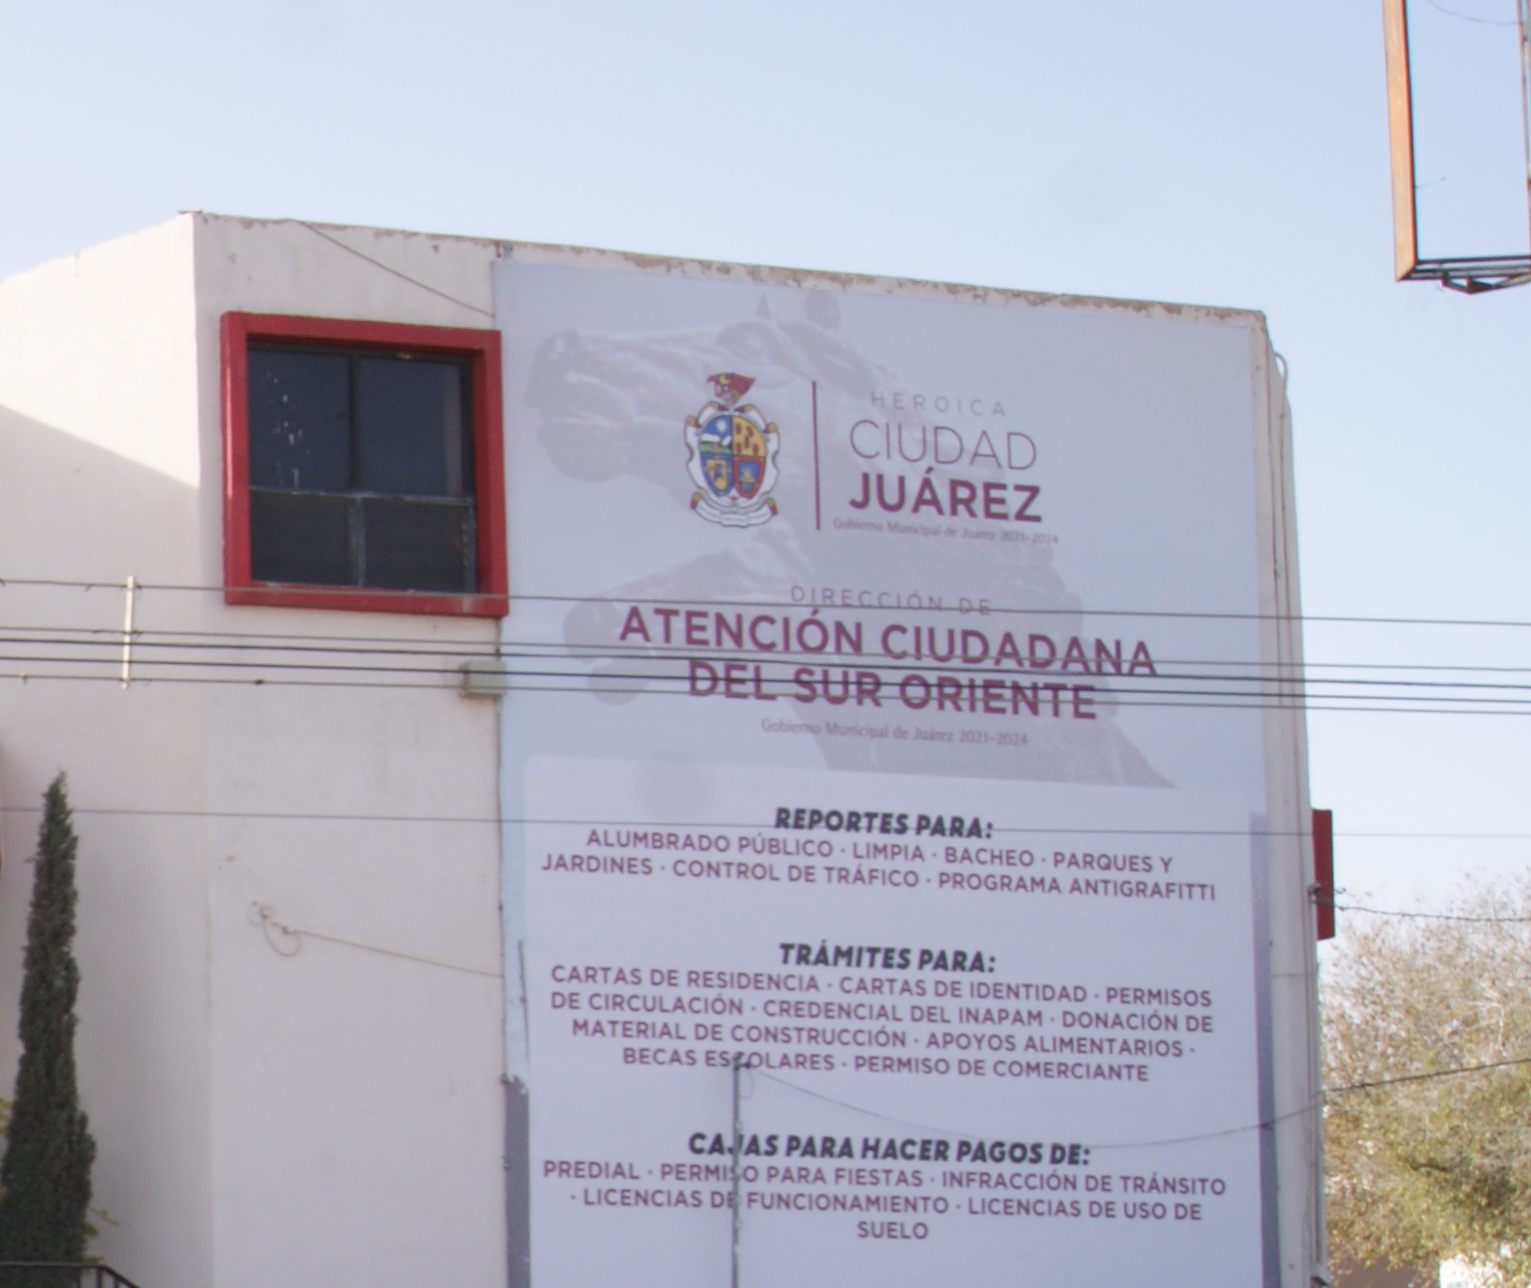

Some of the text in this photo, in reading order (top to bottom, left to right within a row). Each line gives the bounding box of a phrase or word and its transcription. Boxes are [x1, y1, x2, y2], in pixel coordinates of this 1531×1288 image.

[870, 391, 1006, 417] HEROICA
[849, 419, 1037, 471] CIUDAD
[849, 466, 1042, 523] JUÁREZ
[833, 517, 883, 532] Gobierno
[888, 521, 941, 539] Municipal
[945, 527, 958, 537] de
[791, 585, 989, 616] DIRECCIÓN DE
[619, 606, 1158, 675] ATENCIÓN CIUDADANA
[690, 660, 1097, 719] DEL SUR ORIENTE
[761, 718, 1028, 746] Gobierno Municipal de Juárez 2021-2024
[774, 807, 993, 840] REPORTES PARA:
[587, 828, 1172, 874] ALUMBRADO PÚBLICO LIMPIA BACHEO PARQUES Y
[542, 853, 1215, 902] JARDINES CONTROL DE TRÁFICO PROGRAMA ANTIGRAFITTI
[780, 940, 995, 974] TRÁMITES PARA:
[551, 964, 1212, 1008] CARTAS DE RESIDENCIA CARTAS DE IDENTIDAD PERMISOS
[551, 991, 1213, 1034] DE CIRCULACIÓN CREDENCIAL DEL INAPAM DONACIÓN DE
[572, 1018, 1183, 1058] MATERIAL DE CONSTRUCCIÓN APOYOS ALIMENTARIOS
[623, 1046, 697, 1066] BECAS
[854, 1055, 950, 1075] PERMISO
[958, 1058, 985, 1077] DE
[993, 1059, 1148, 1082] COMERCIANTE
[688, 1132, 1090, 1166] CAJAS PARA HACER PAGOS DE:
[543, 1160, 640, 1181] PREDIAL
[767, 1165, 827, 1184] PARA
[835, 1167, 923, 1187] FIESTAS
[943, 1169, 1077, 1192] INFRACCIÓN
[1085, 1174, 1112, 1193] DE
[1119, 1171, 1226, 1197] TRÁNSITO
[584, 1187, 702, 1209] LICENCIAS
[747, 1191, 949, 1215] FUNCIONAMIENTO
[968, 1197, 1082, 1218] LICENCIAS
[1089, 1200, 1116, 1218] DE
[1124, 1201, 1167, 1220] USO
[1174, 1203, 1202, 1221] DE
[857, 1220, 929, 1240] SUELO
